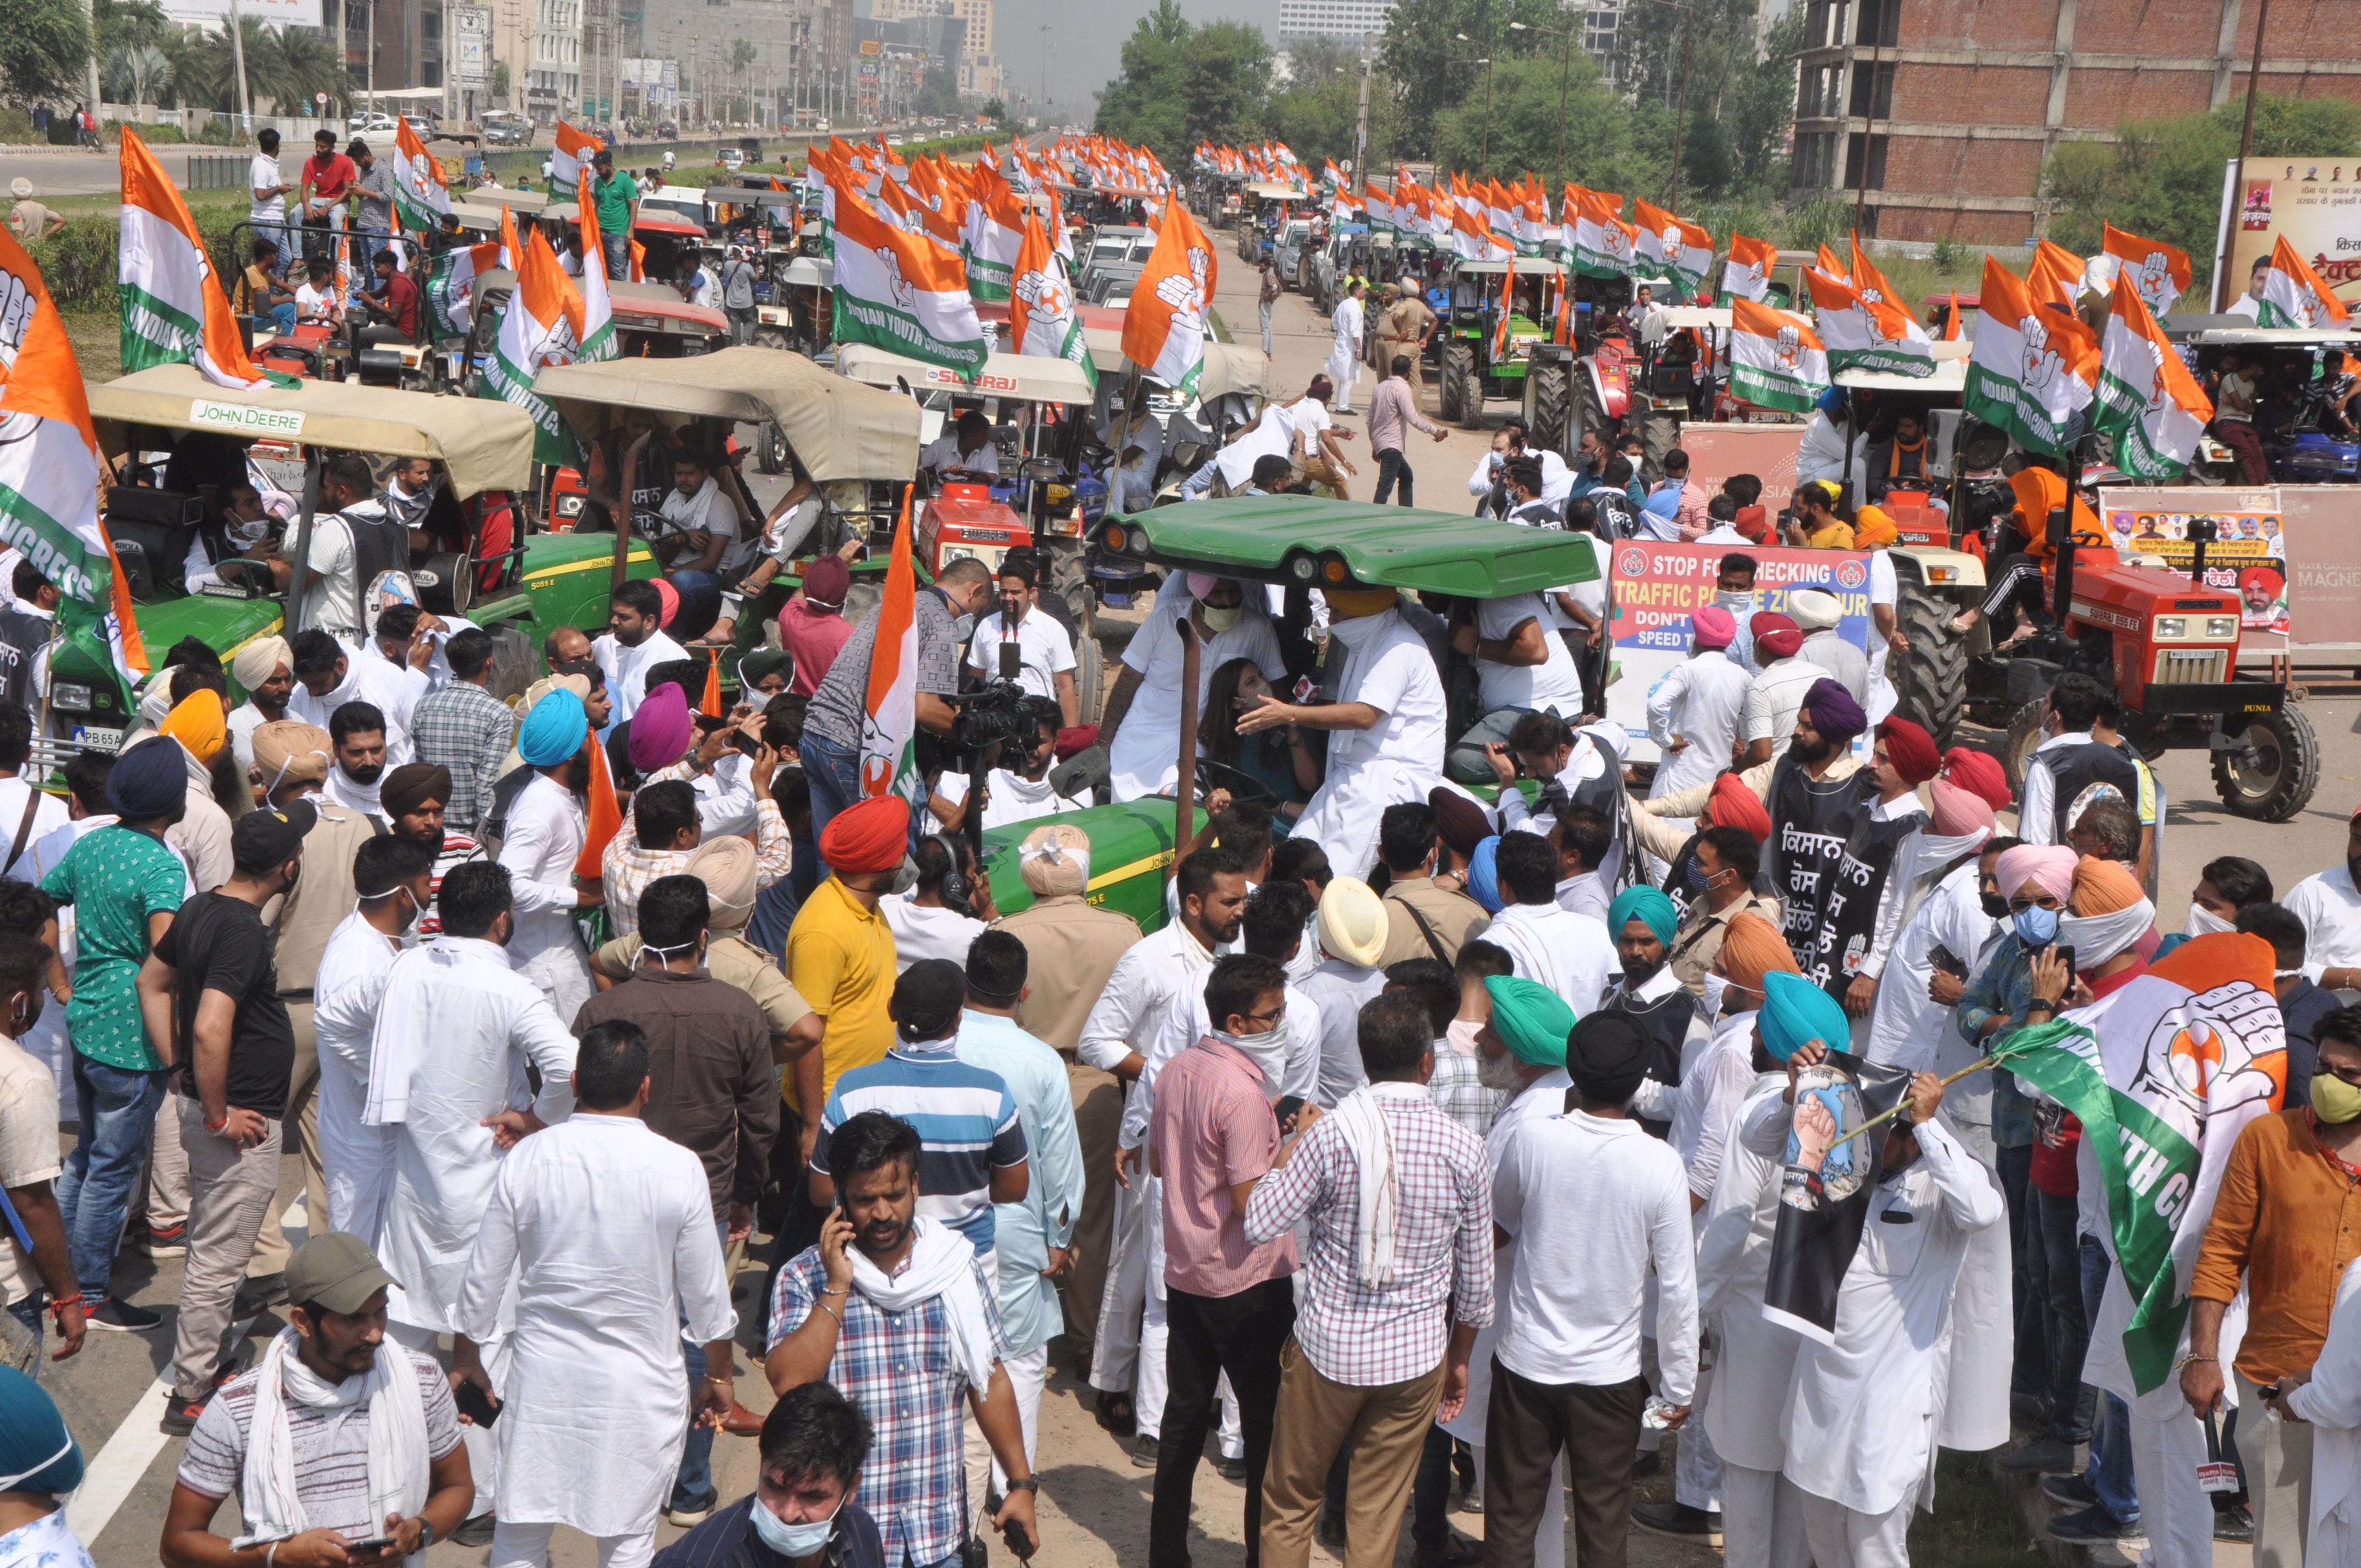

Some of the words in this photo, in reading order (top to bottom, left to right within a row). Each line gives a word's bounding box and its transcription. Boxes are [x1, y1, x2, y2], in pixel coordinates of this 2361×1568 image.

[130, 302, 182, 351] INDIAN
[886, 312, 922, 346] YOUTH
[1736, 369, 1765, 389] INDIAN
[1765, 377, 1790, 391] YOUTH
[198, 404, 243, 423] JOHN
[245, 411, 300, 429] DEERE
[0, 510, 95, 605] NGRESS
[1653, 556, 1697, 576] STOP
[1702, 558, 1720, 578] FO
[1756, 563, 1830, 584] HECKING
[2298, 571, 2361, 587] MAGNE
[531, 580, 549, 590] 5055
[1614, 580, 1692, 607] TRAFFIC
[2115, 613, 2130, 628] 855
[2130, 618, 2137, 630] FE
[1638, 630, 1681, 646] SPEED
[85, 732, 99, 743] PB
[1782, 821, 1846, 859] ਕਿਸਾਨ
[1150, 855, 1170, 869] JOHN
[1791, 859, 1820, 894] ਰੋਸ
[1086, 896, 1097, 907] 75
[1098, 893, 1105, 903] E
